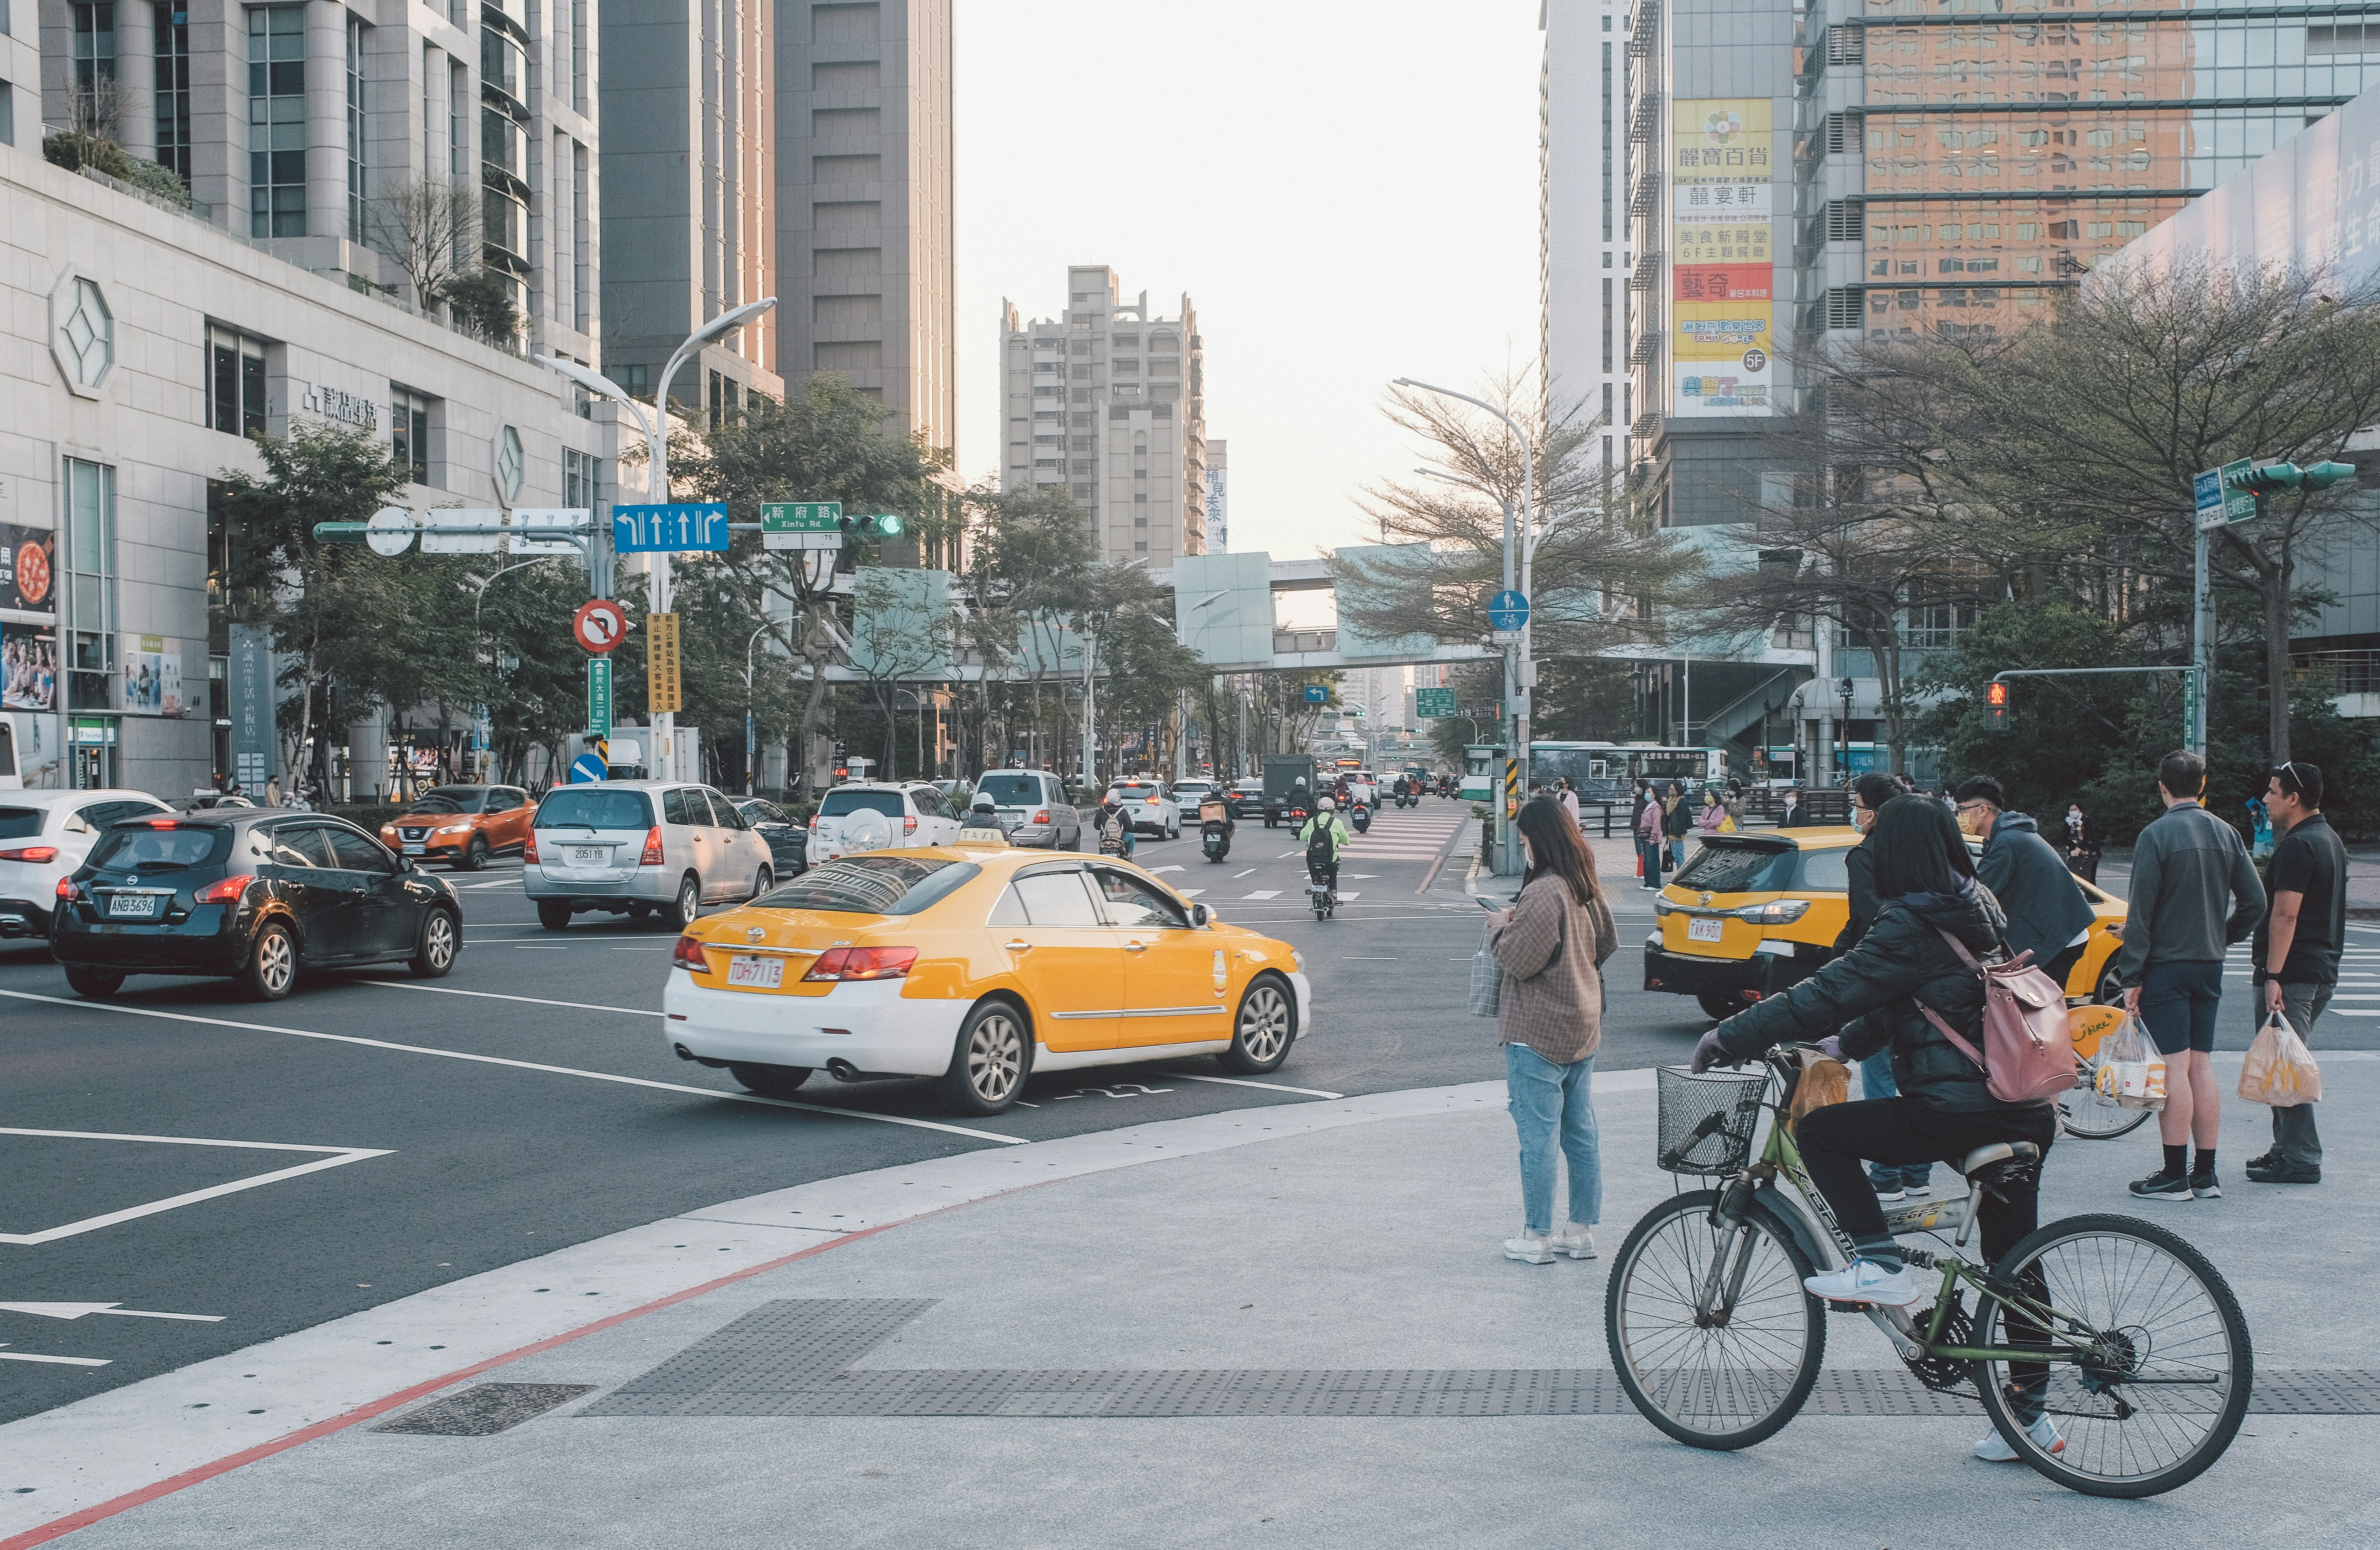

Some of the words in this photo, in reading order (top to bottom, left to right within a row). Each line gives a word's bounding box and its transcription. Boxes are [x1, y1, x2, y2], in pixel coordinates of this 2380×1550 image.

[1679, 148, 1768, 166] 麗寶百貨
[1680, 230, 1767, 244] 美食新殿堂
[1746, 354, 1762, 368] 5F
[772, 506, 830, 519] 新府路
[963, 831, 994, 840] TAXI
[111, 899, 153, 912] ANB-3696
